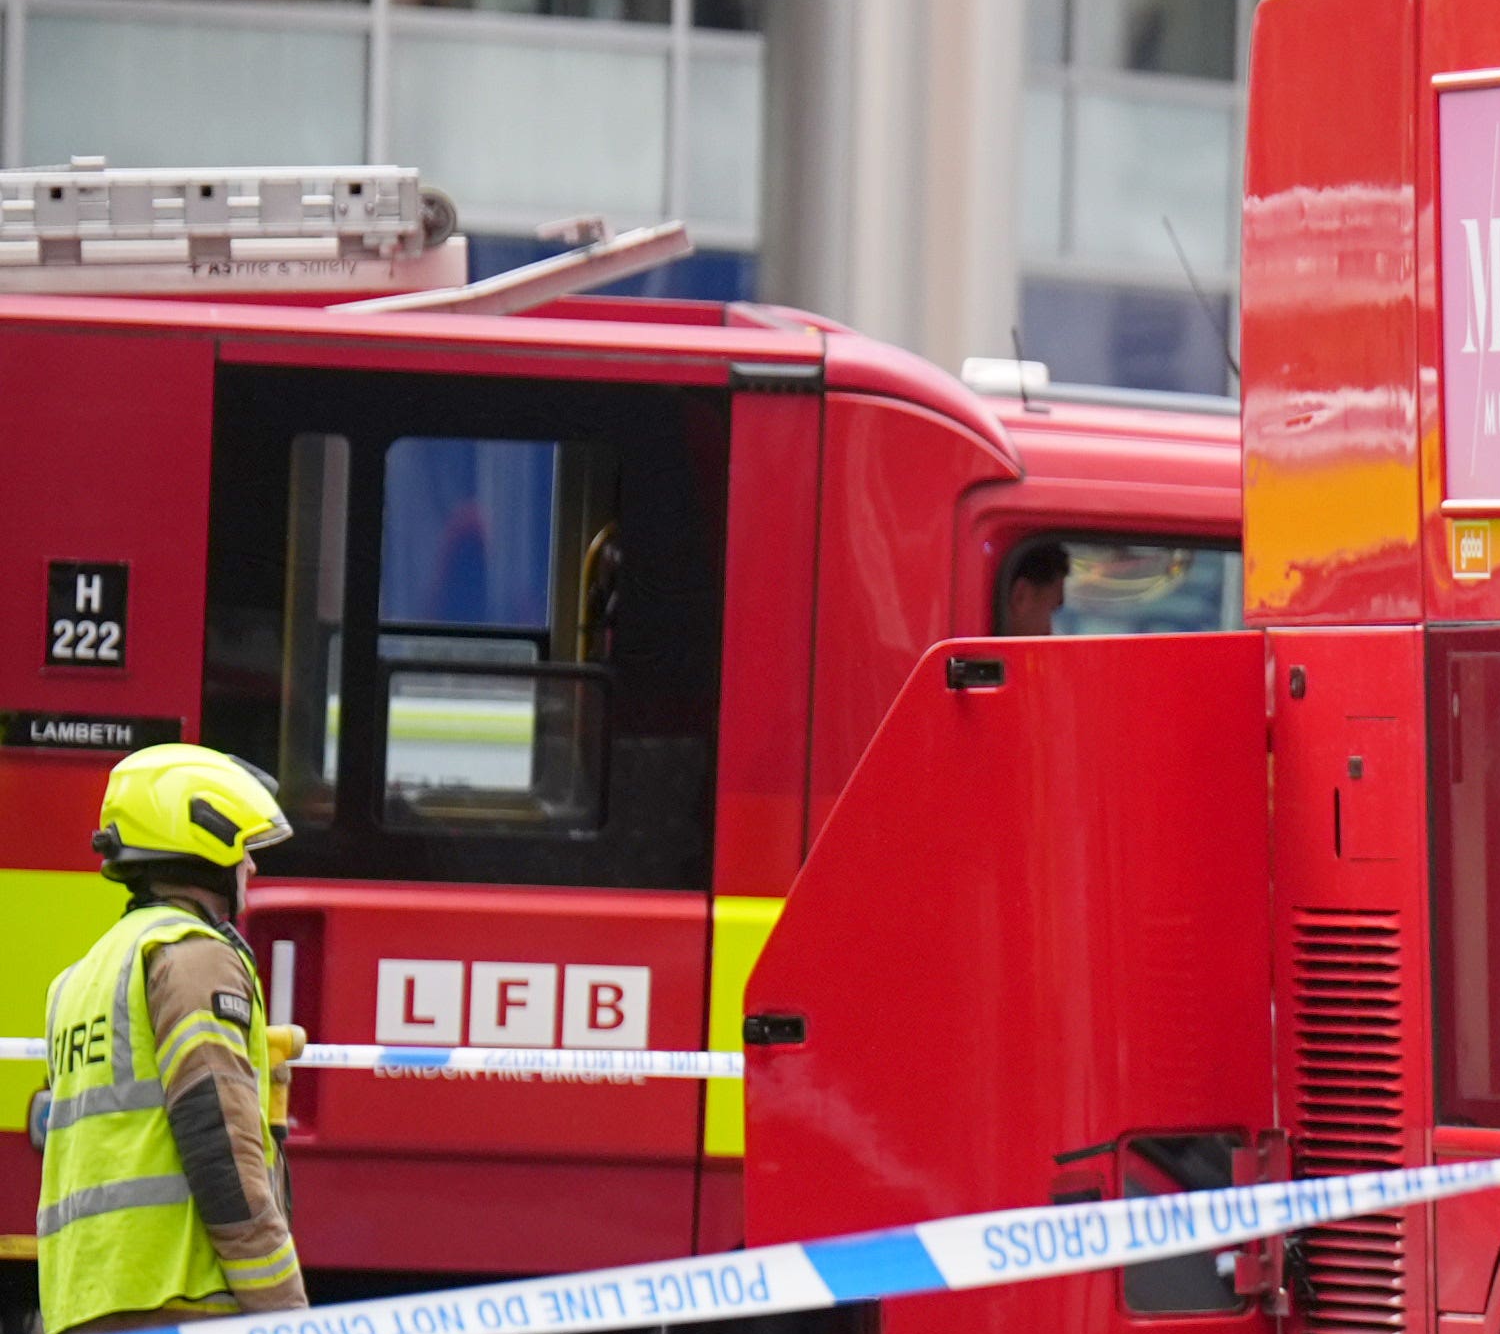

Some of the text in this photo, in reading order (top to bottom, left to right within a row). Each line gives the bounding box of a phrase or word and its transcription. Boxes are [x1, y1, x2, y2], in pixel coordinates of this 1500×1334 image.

[75, 573, 102, 614] H
[51, 618, 121, 661] 222
[29, 720, 133, 746] LAMBETH
[1123, 1193, 1197, 1249] NOT
[1203, 1187, 1260, 1235] DO
[982, 1218, 1111, 1273] CROSS
[474, 1294, 531, 1328] DO
[540, 1281, 628, 1323] LINE
[634, 1260, 773, 1321] POLICE
